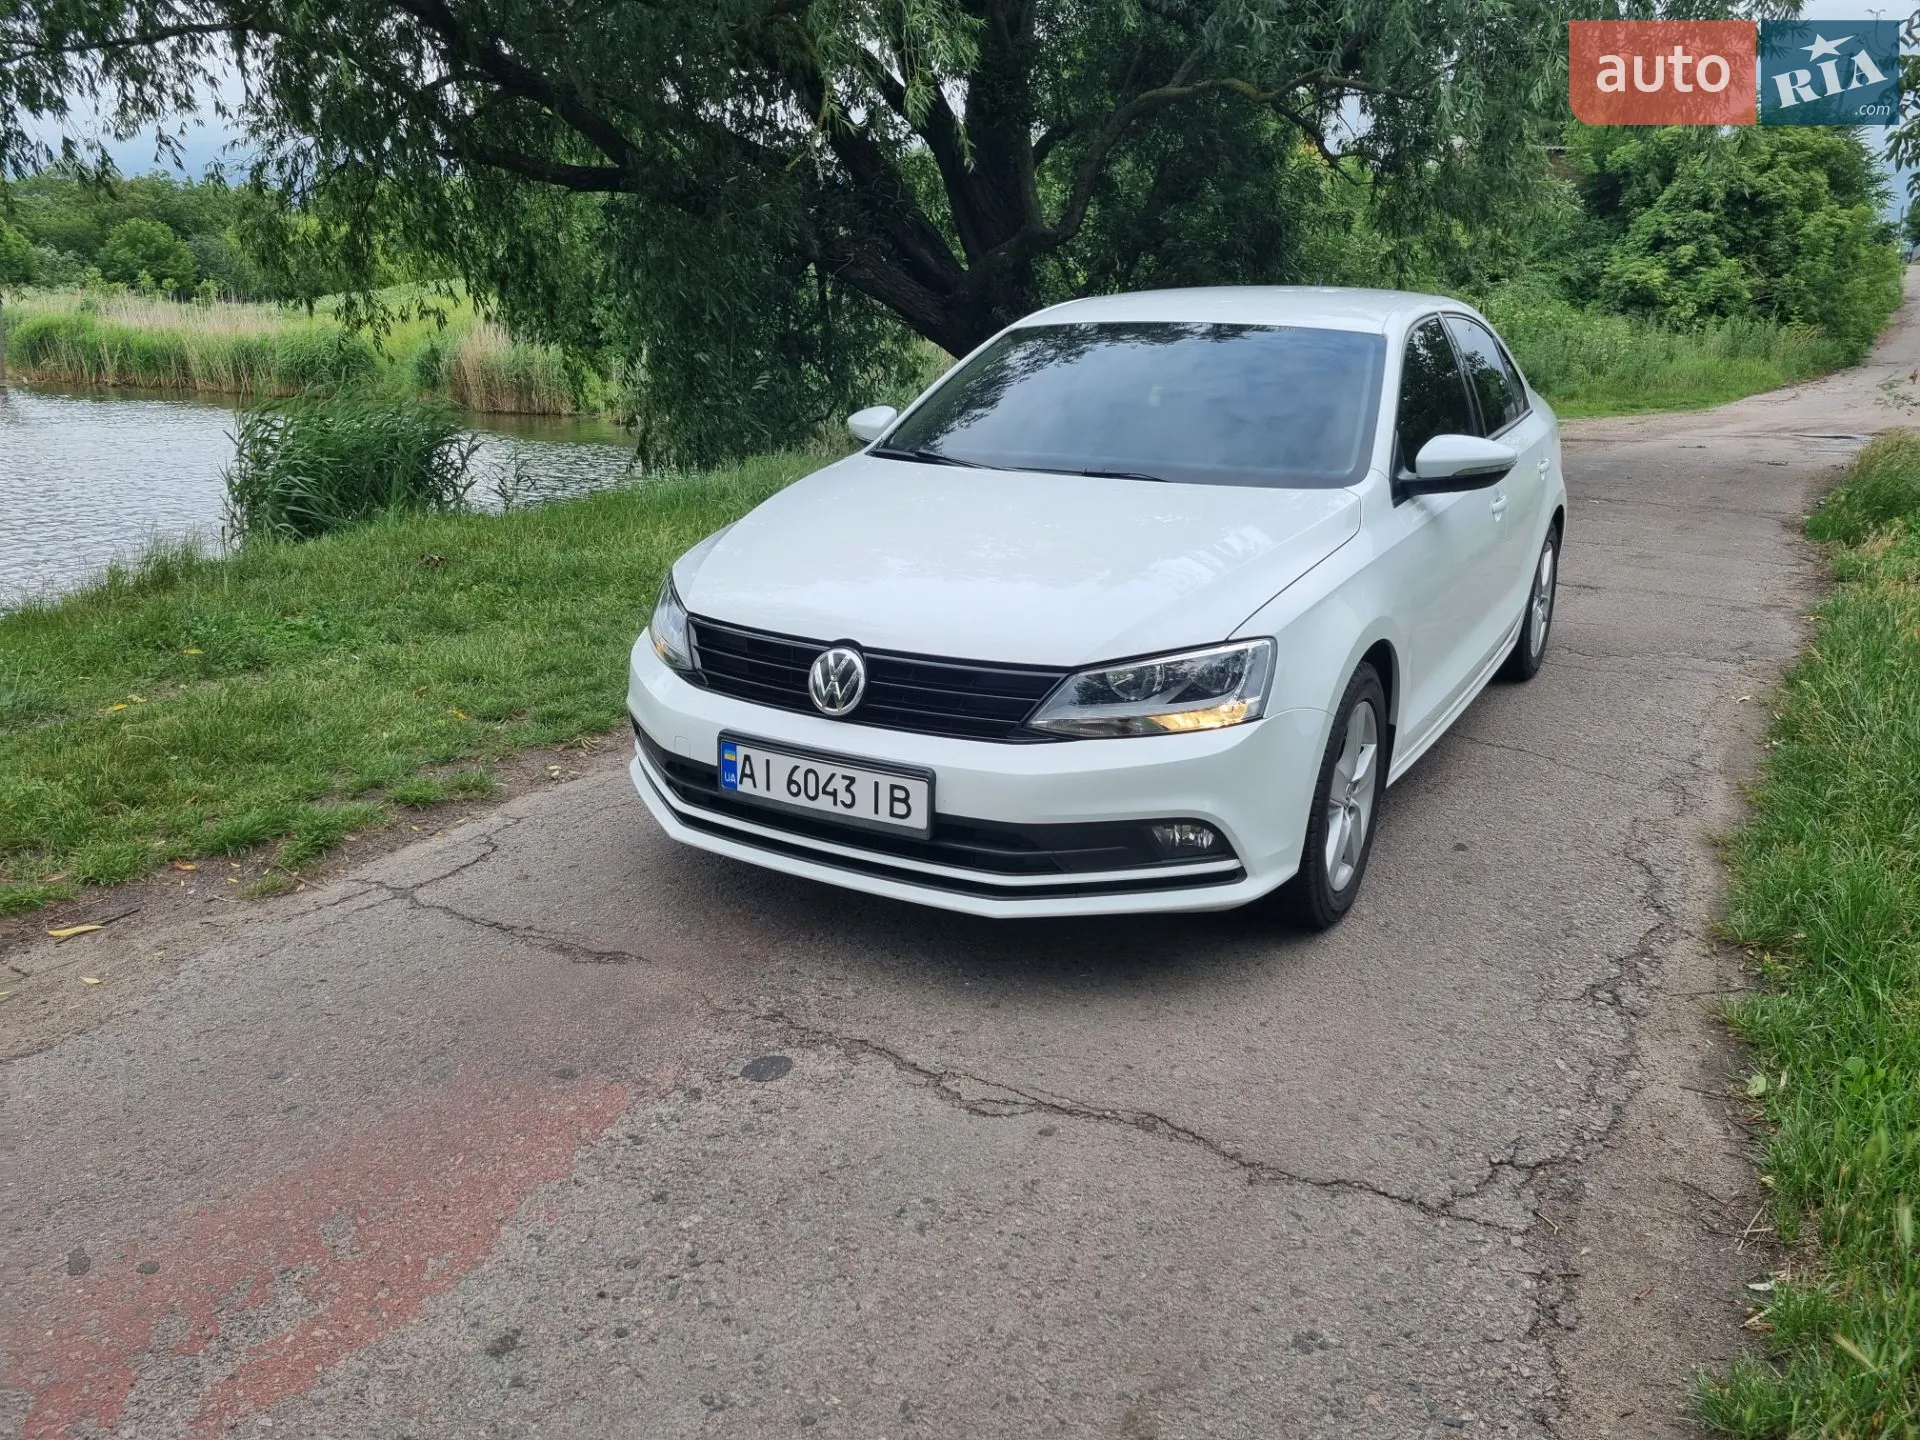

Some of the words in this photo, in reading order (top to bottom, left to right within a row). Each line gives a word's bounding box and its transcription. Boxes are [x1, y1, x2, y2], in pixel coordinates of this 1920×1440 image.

[724, 771, 737, 785] UA
[738, 754, 771, 792] AI
[786, 765, 856, 809] 6043
[873, 780, 912, 820] IB
